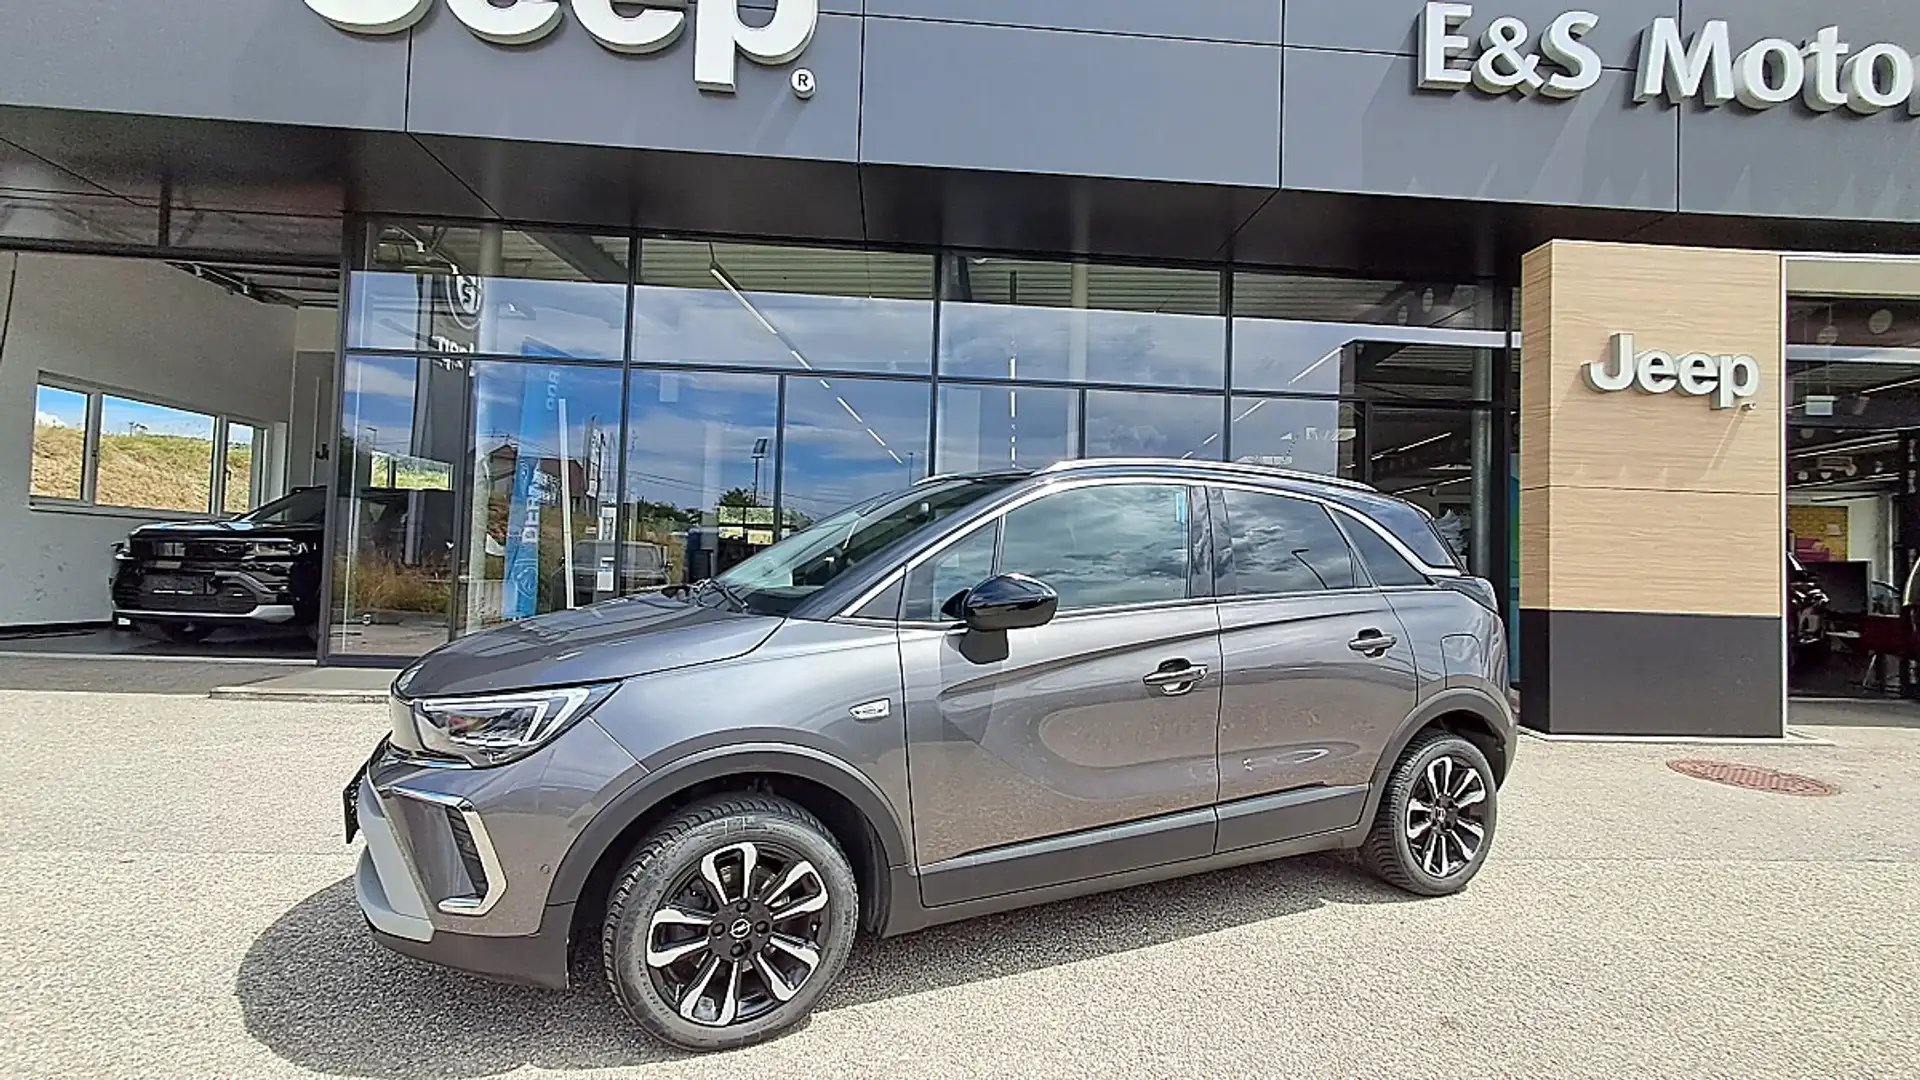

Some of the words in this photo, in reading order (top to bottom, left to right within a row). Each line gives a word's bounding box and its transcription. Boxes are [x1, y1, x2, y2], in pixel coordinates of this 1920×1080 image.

[305, 0, 819, 93] ep
[1418, 1, 1602, 98] E&S
[1632, 16, 1920, 116] Moto
[1580, 332, 1761, 410] Jeep
